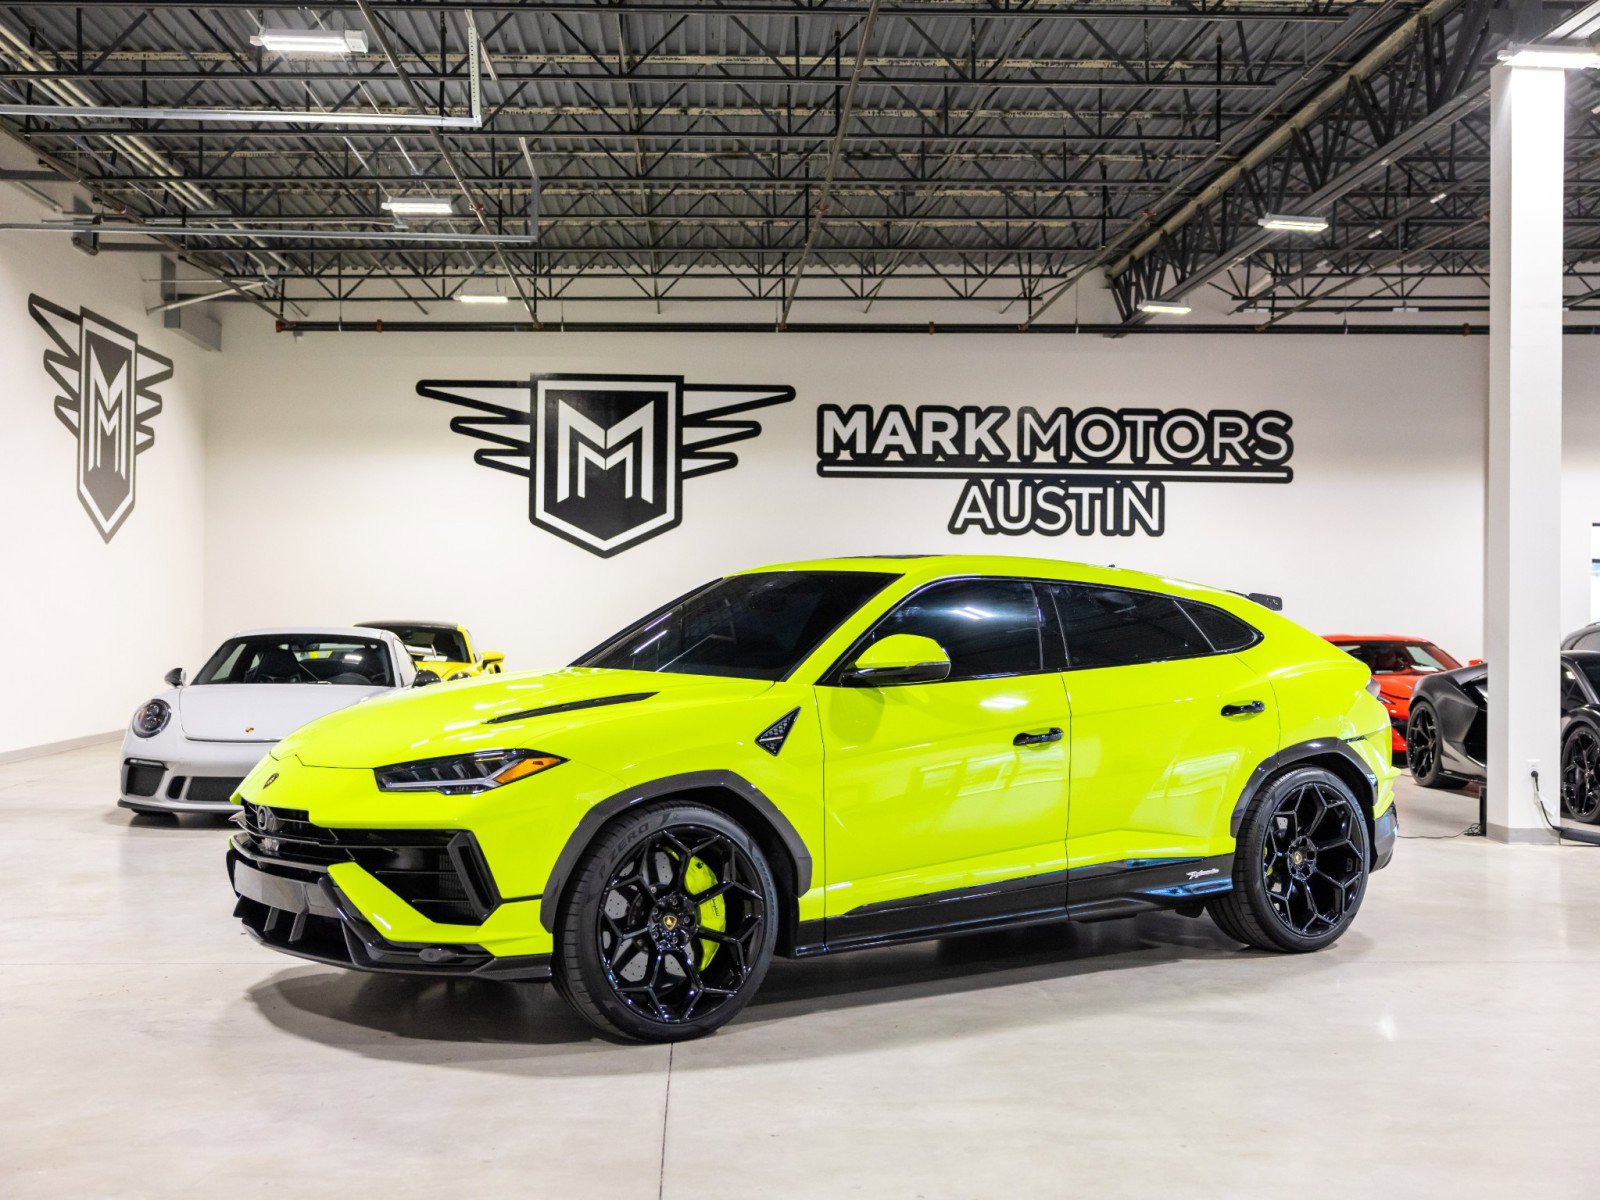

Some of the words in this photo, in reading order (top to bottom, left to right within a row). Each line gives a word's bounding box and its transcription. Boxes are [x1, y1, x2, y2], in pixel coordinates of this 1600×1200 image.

[821, 409, 1005, 457] MARK
[1022, 411, 1289, 462] MOTORS
[953, 484, 1160, 532] AUSTIN
[610, 822, 650, 864] ZERO
